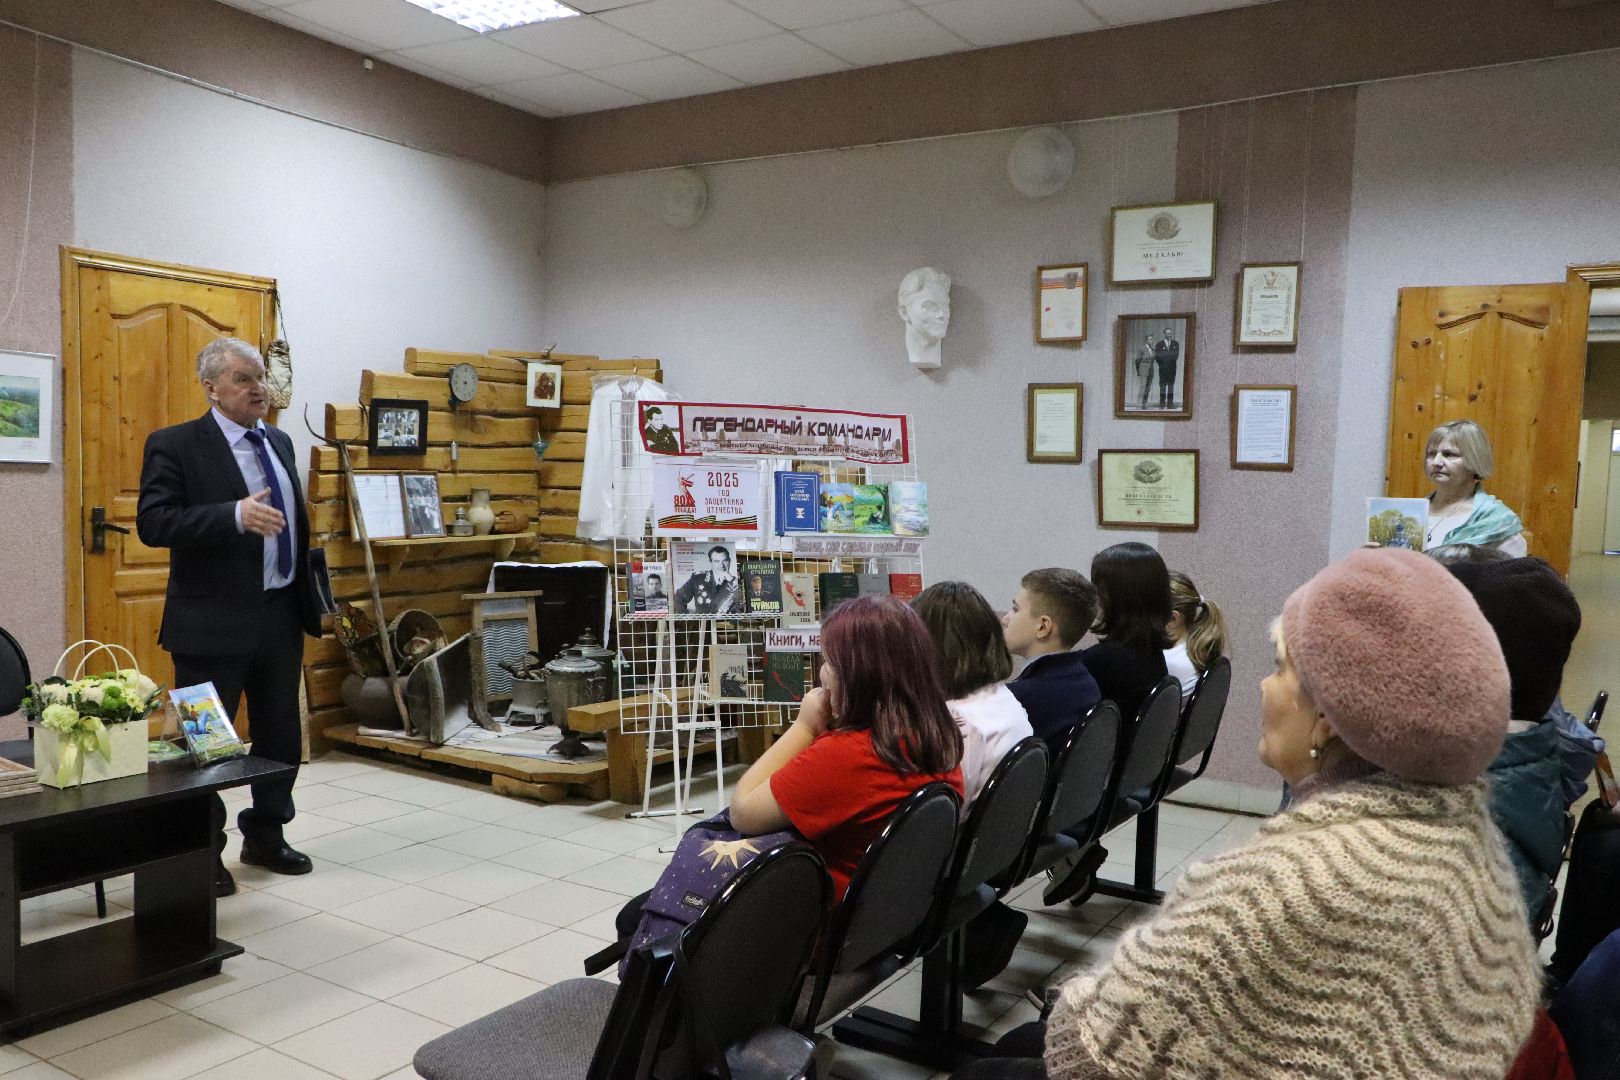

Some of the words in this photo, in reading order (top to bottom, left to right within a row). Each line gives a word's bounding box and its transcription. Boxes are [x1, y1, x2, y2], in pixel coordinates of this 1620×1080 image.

[692, 416, 802, 436] ЛЕГЕНДАРНЫЙ
[807, 422, 892, 442] КОМАНДАРМ
[707, 472, 739, 487] 2025
[718, 489, 730, 497] ГОД
[673, 494, 686, 506] 80
[704, 497, 744, 506] ЗАЩИТНИКА
[706, 506, 743, 515] ОТЕЧЕСТВА
[750, 601, 780, 611] ЧУЙКОВ
[768, 631, 805, 649] Книги,
